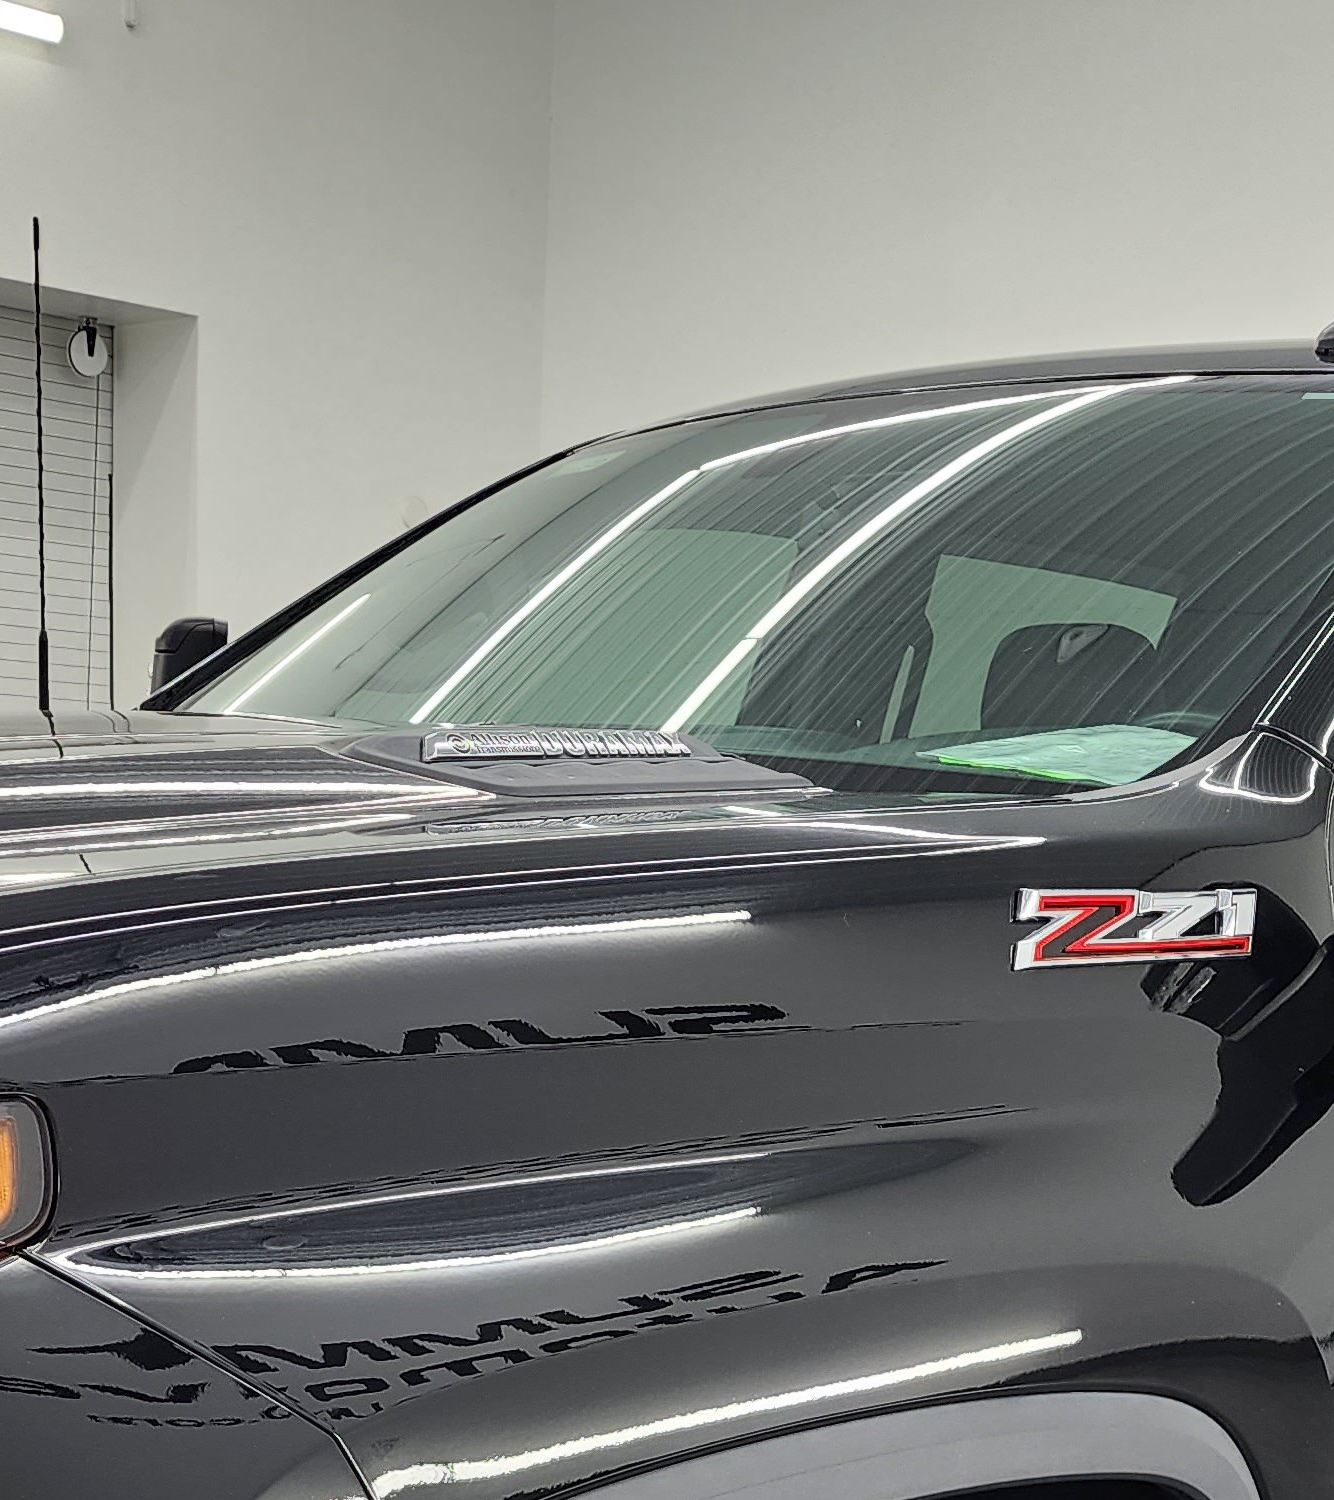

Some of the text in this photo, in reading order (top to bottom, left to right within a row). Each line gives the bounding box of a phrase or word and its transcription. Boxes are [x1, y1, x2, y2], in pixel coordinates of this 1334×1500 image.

[470, 732, 532, 746] Allison
[531, 730, 692, 758] DURAMAX
[1011, 888, 1257, 971] Z71
